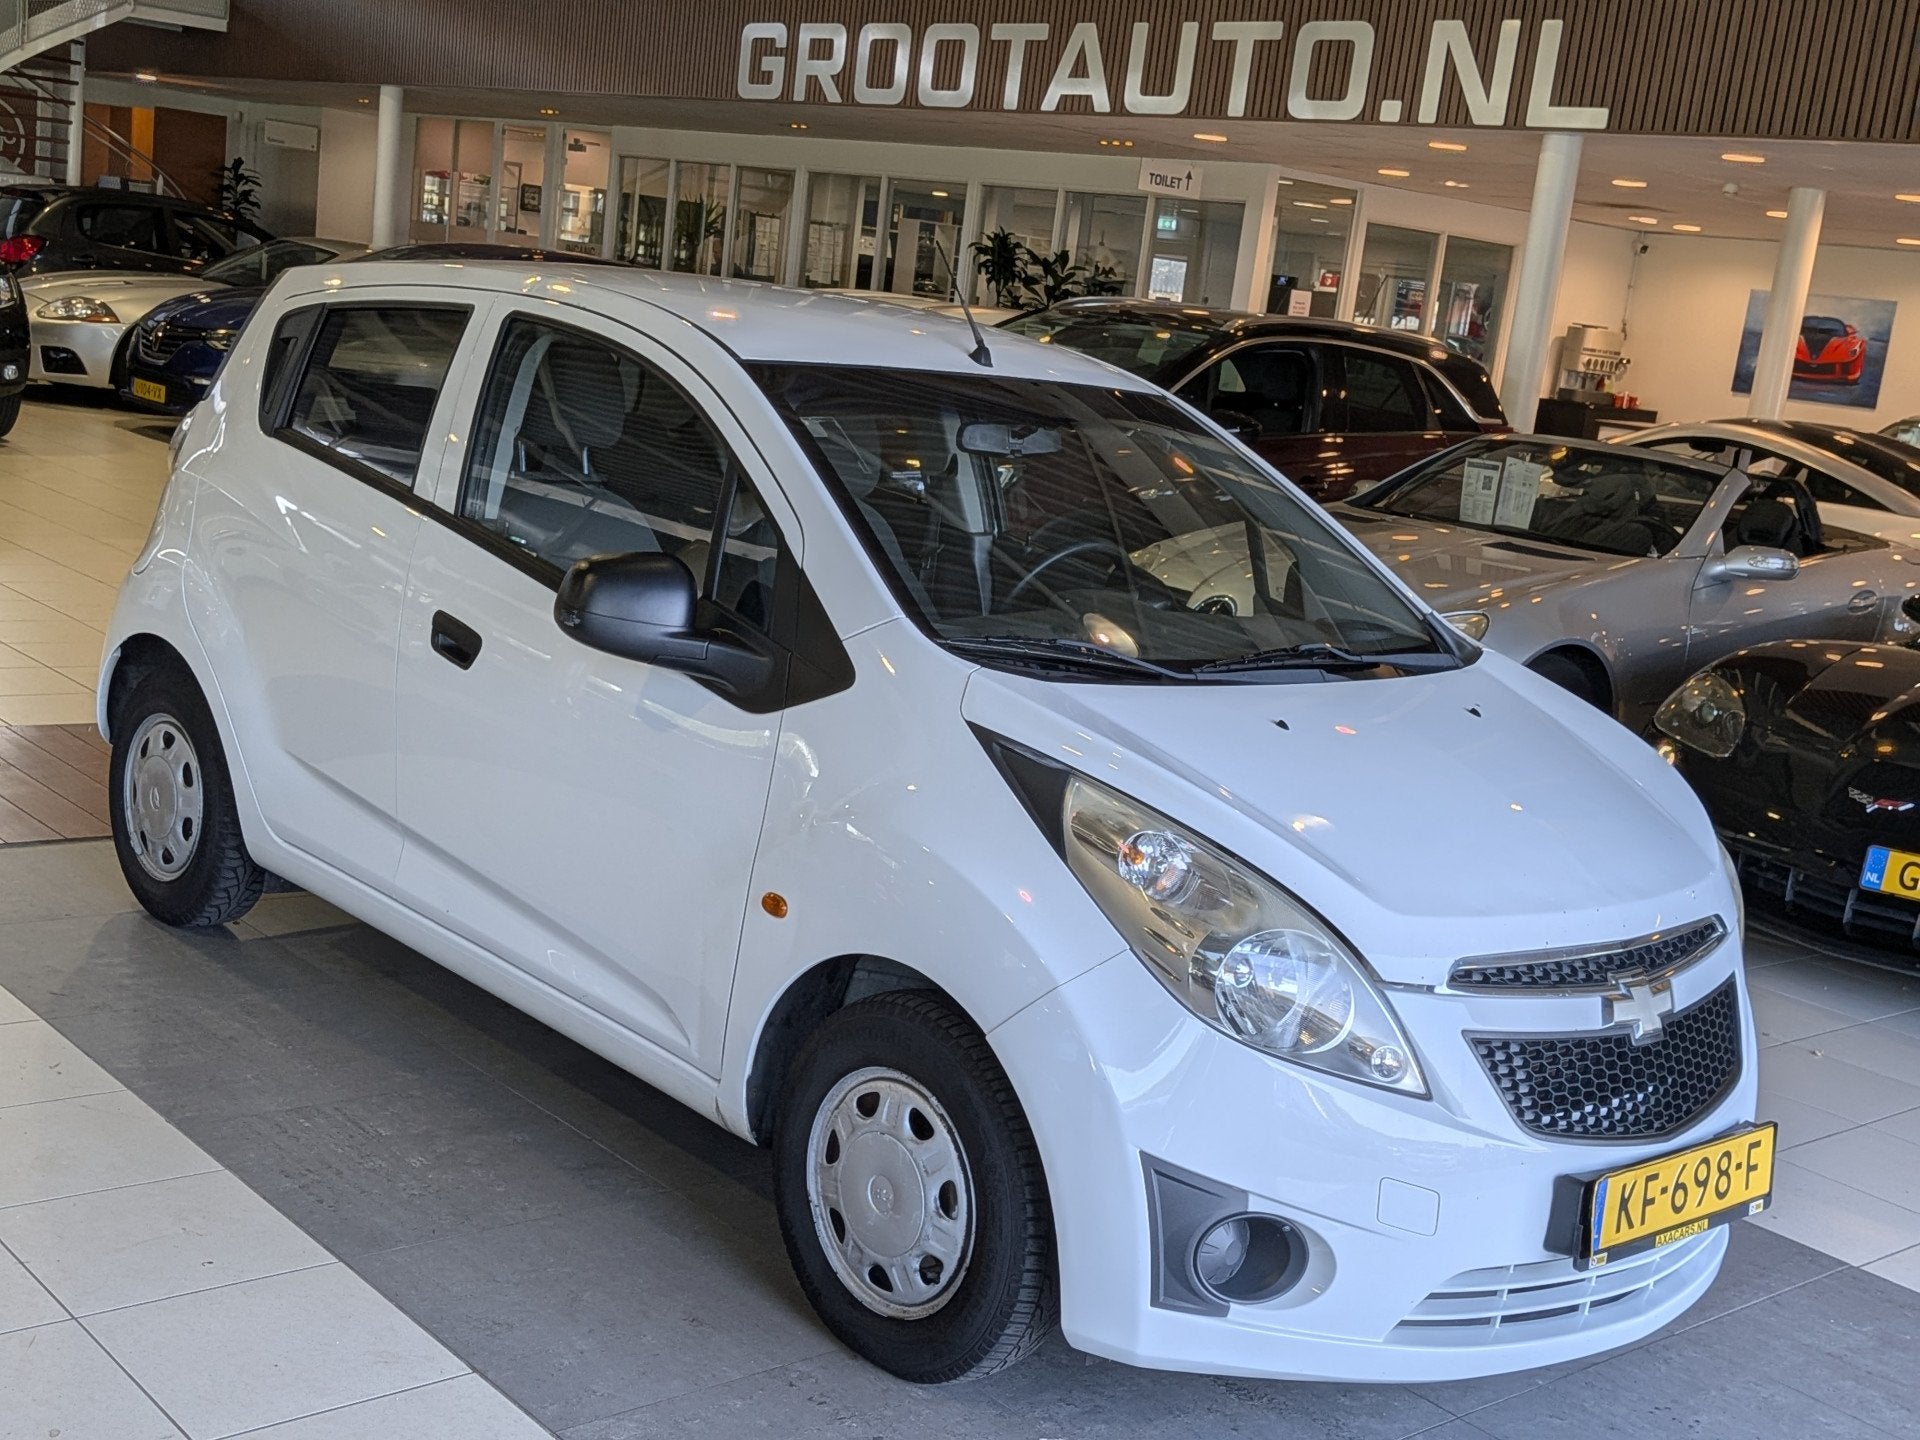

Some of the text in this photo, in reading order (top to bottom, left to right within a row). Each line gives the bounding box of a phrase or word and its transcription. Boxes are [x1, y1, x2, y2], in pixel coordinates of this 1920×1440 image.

[737, 20, 1609, 129] GROOTAUTO.NL
[1149, 172, 1182, 190] TOILET
[1865, 871, 1880, 884] NL
[1615, 1140, 1762, 1235] KF-698-F
